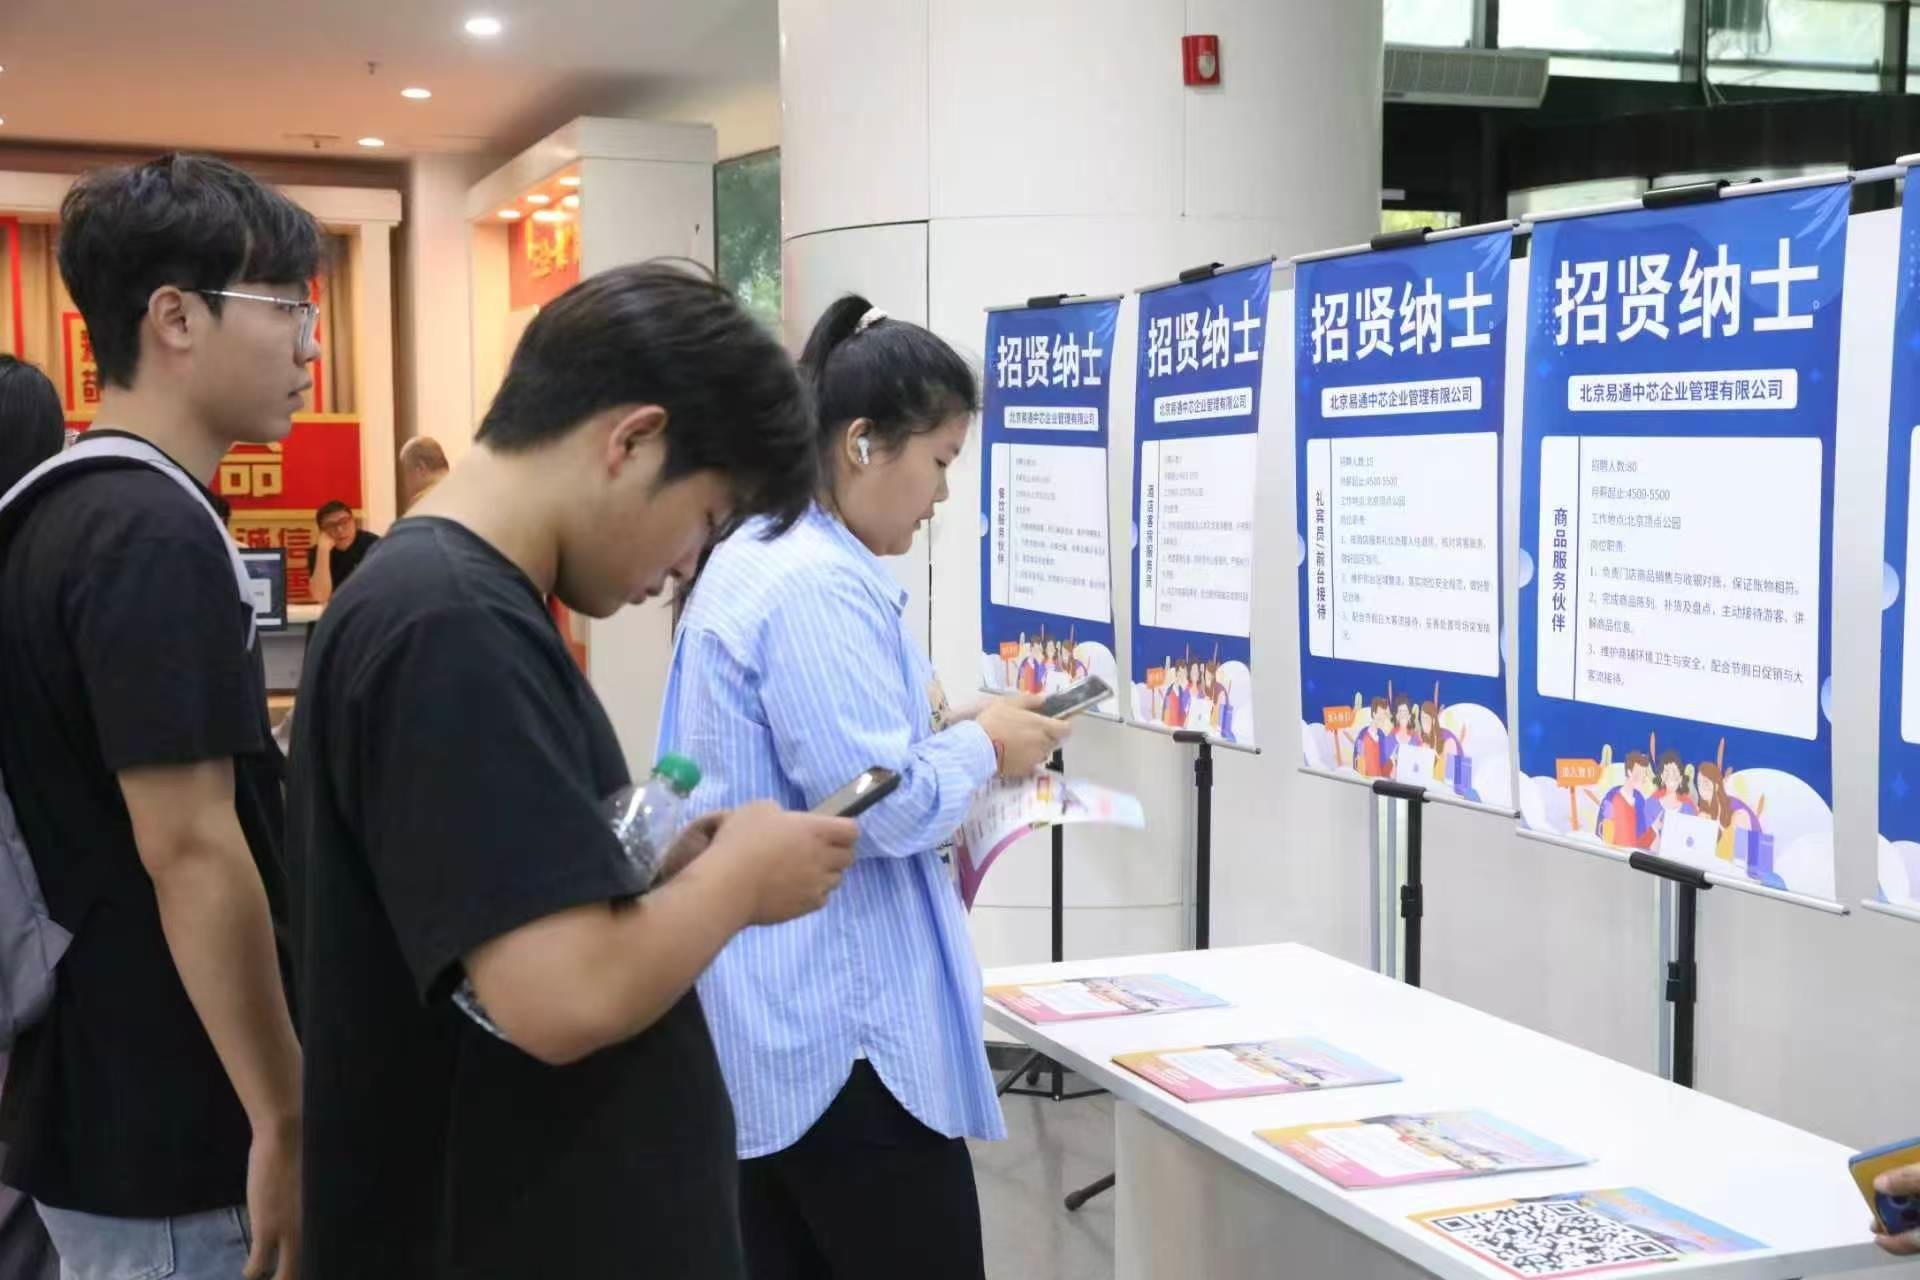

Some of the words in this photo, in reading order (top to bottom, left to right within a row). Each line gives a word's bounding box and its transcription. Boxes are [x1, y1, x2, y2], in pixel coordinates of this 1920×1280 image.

[1311, 271, 1493, 364] 招贤纳士
[1555, 238, 1819, 346] 招贤纳士
[997, 331, 1103, 388] 招贤纳士
[1148, 300, 1261, 378] 招贤纳士
[1330, 385, 1472, 411] 北京易通中芯企业管理有限公司
[1580, 379, 1783, 403] 北京易通中芯企业管理有限公司
[1552, 507, 1568, 633] 商品服务伙伴
